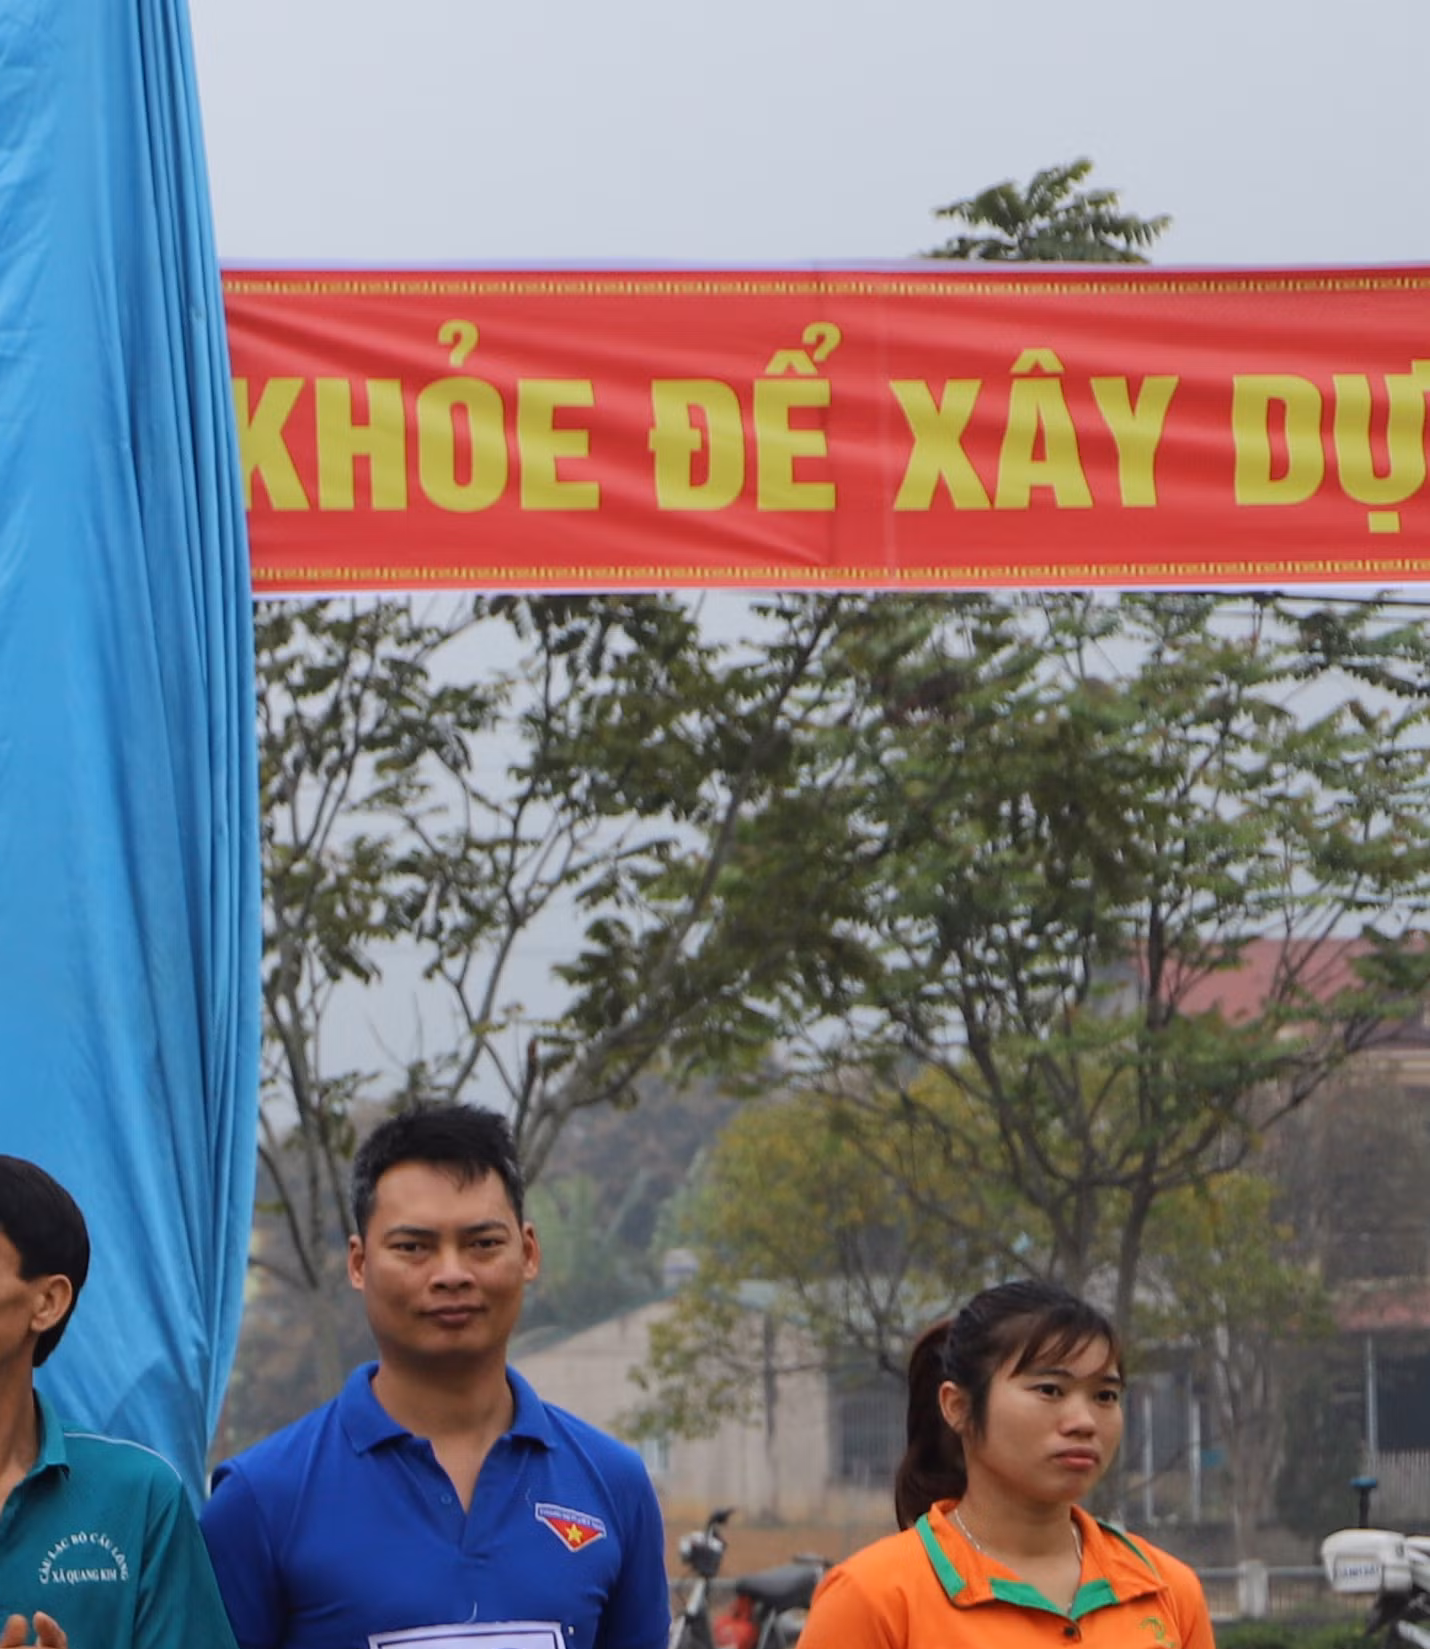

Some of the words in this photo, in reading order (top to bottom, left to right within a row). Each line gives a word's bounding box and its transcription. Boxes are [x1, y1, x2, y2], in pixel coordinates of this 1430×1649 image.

[233, 318, 600, 513] KHỎE
[649, 320, 840, 513] ĐỂ
[891, 347, 1180, 512] XÂY
